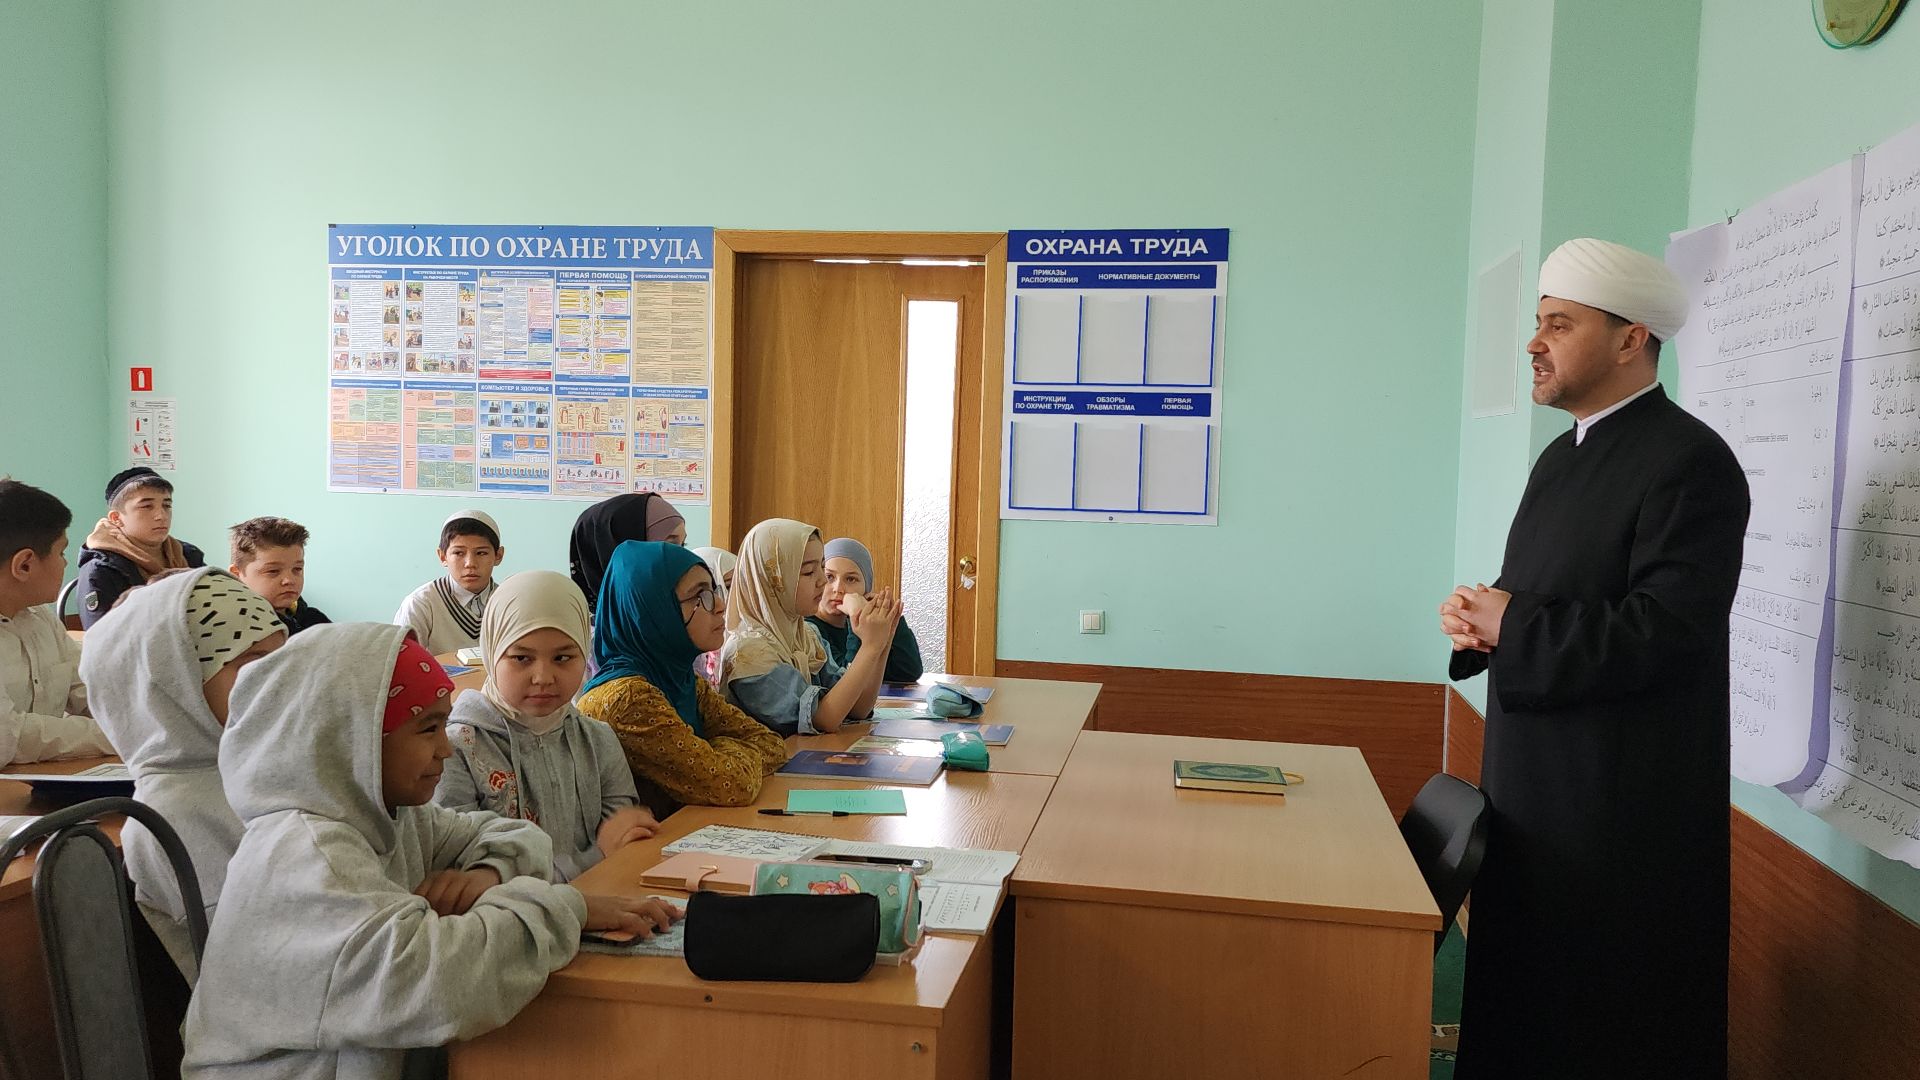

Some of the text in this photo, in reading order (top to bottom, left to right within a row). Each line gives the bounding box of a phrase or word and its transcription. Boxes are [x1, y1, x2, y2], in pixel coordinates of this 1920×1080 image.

[336, 235, 704, 265] УГОЛОК ПО ОХРАНЕ ТРУДА
[1025, 238, 1209, 258] ОХРАНА ТРУДА
[559, 271, 590, 279] ПЕРВАЯ
[592, 272, 629, 281] ПОМОЩЬ
[1021, 276, 1079, 284] РАСПОРЯЖЕНИЯ
[1154, 273, 1201, 281] ДОКУМЕНТЫ
[1096, 396, 1126, 404] ОБЗОРЫ
